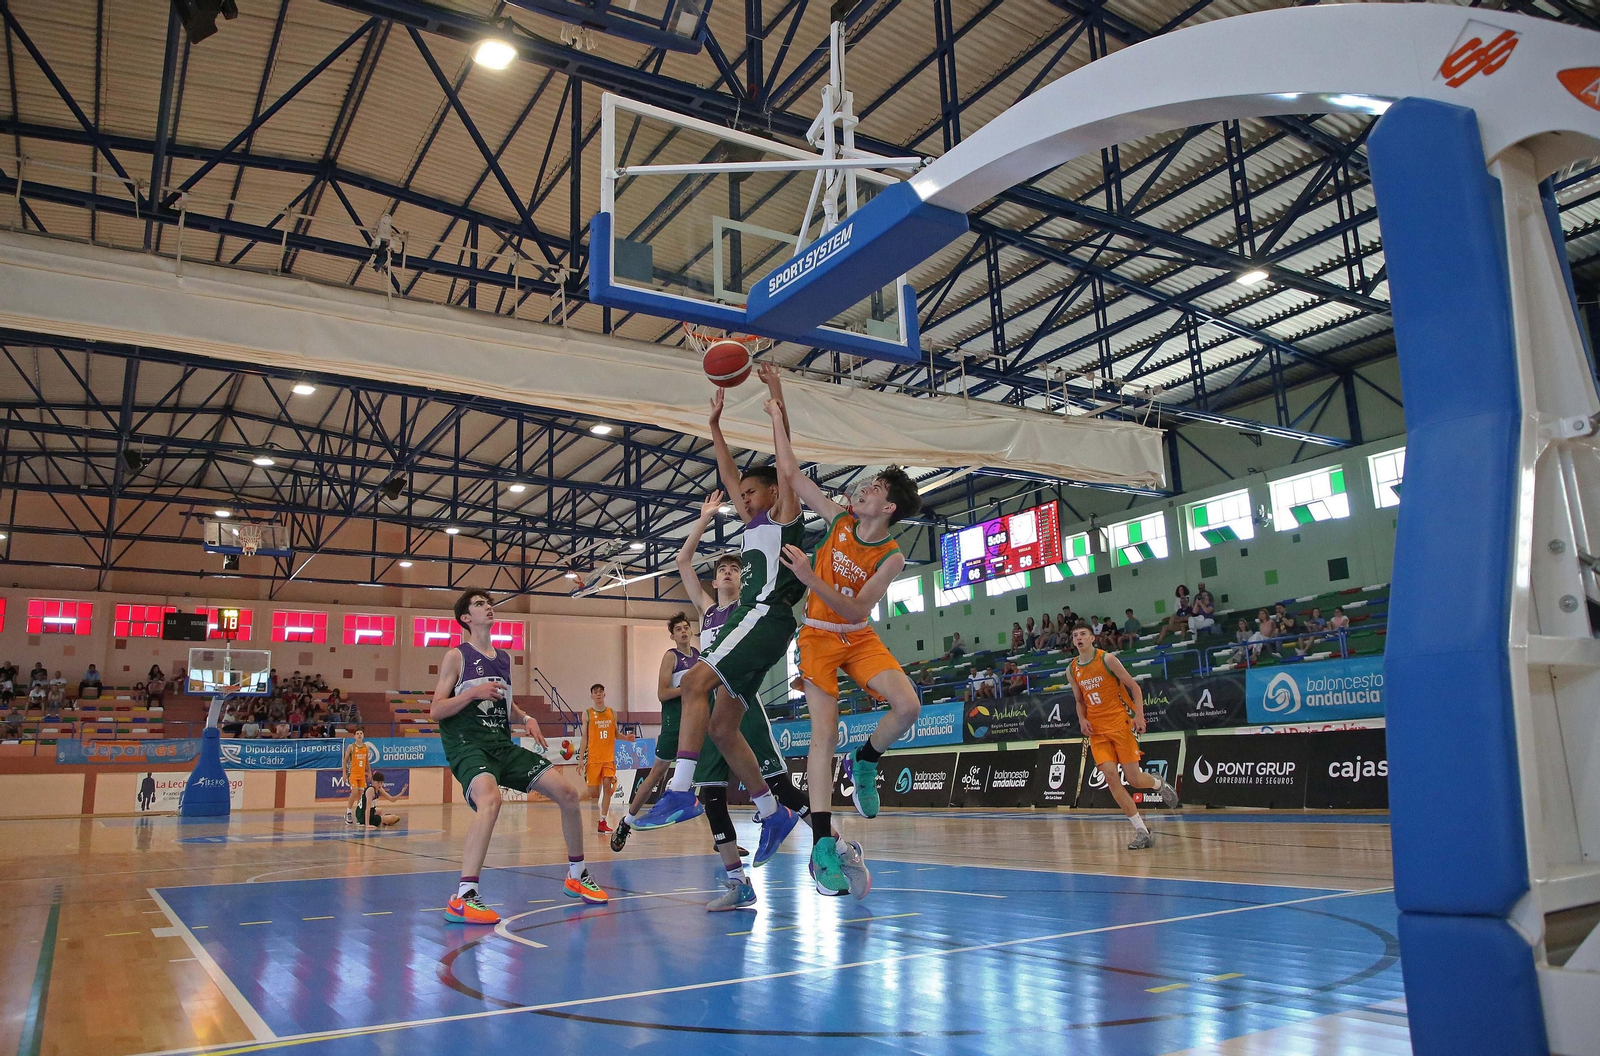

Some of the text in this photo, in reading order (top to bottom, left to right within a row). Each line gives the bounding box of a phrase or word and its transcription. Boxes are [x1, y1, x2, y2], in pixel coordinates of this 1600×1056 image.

[768, 222, 854, 293] SPORT SYSTEM
[987, 532, 1007, 546] 5:05
[1019, 555, 1033, 568] 56
[223, 617, 238, 630] 18
[1306, 672, 1384, 692] baloncesto
[1087, 691, 1102, 706] 15
[917, 713, 955, 727] baloncesto
[849, 721, 879, 734] baloncest
[600, 730, 608, 740] 16
[792, 731, 812, 740] balonces
[82, 740, 178, 760] deportes
[245, 744, 341, 755] Diputación DEPORTES
[382, 744, 427, 754] baloncesto
[245, 755, 285, 765] de Cádiz
[994, 769, 1030, 779] baloncesto
[1216, 761, 1296, 776] PONT GRUP
[914, 770, 947, 781] baloncesto
[1215, 775, 1294, 786] CORREDURÍA DE SEGUROS
[156, 780, 166, 789] La
[168, 780, 188, 789] Lech
[1143, 792, 1164, 803] YouTube
